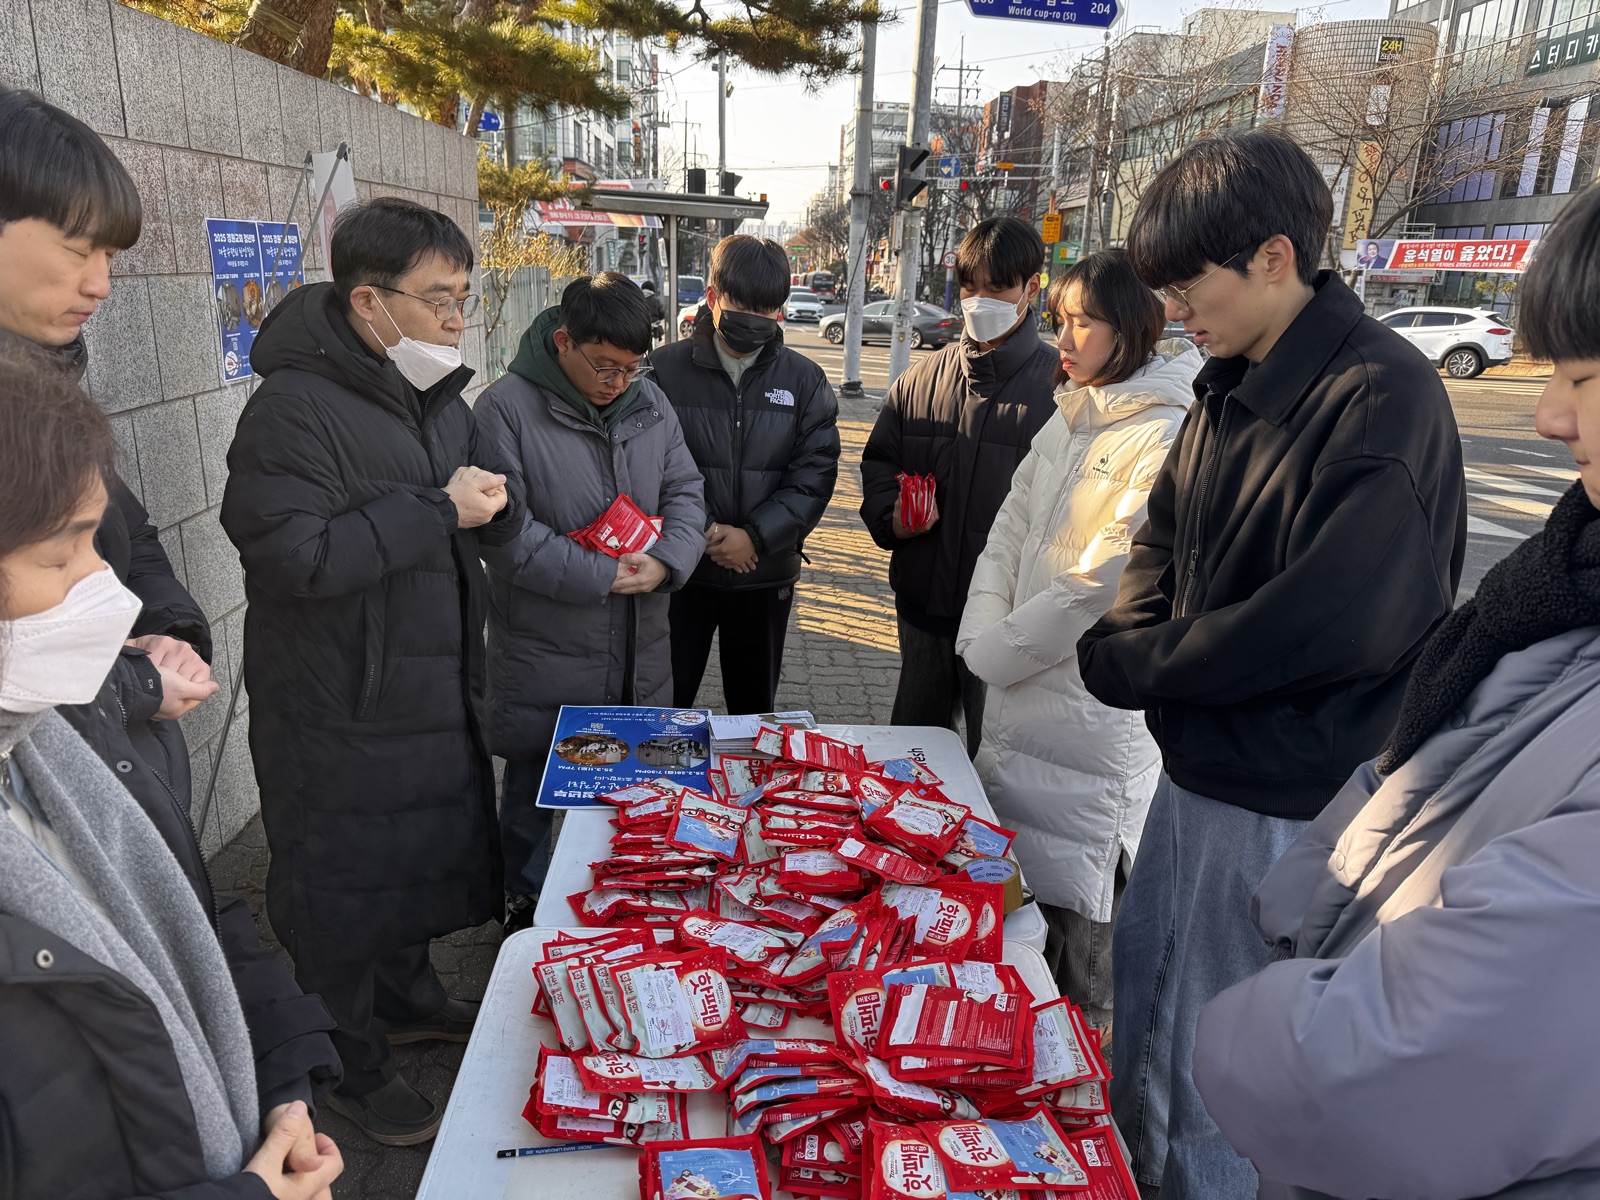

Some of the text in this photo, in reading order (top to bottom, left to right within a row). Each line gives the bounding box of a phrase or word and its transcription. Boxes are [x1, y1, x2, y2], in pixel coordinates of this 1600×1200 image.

[1008, 5, 1077, 22] World cup-ro (St)
[1090, 2, 1111, 15] 204
[1381, 38, 1404, 51] 24H
[1349, 186, 1373, 243] STEAK
[214, 233, 226, 243] 2025
[262, 234, 273, 243] 2025
[945, 256, 957, 265] 30
[1403, 243, 1517, 263] 윤석열이 옳았다!
[765, 391, 785, 399] NORTH
[554, 790, 595, 799] 청년부
[930, 901, 960, 932] 핫팩
[688, 971, 720, 1016] 핫팩
[960, 1128, 998, 1163] 핫팩
[901, 1154, 933, 1192] 핫팩
